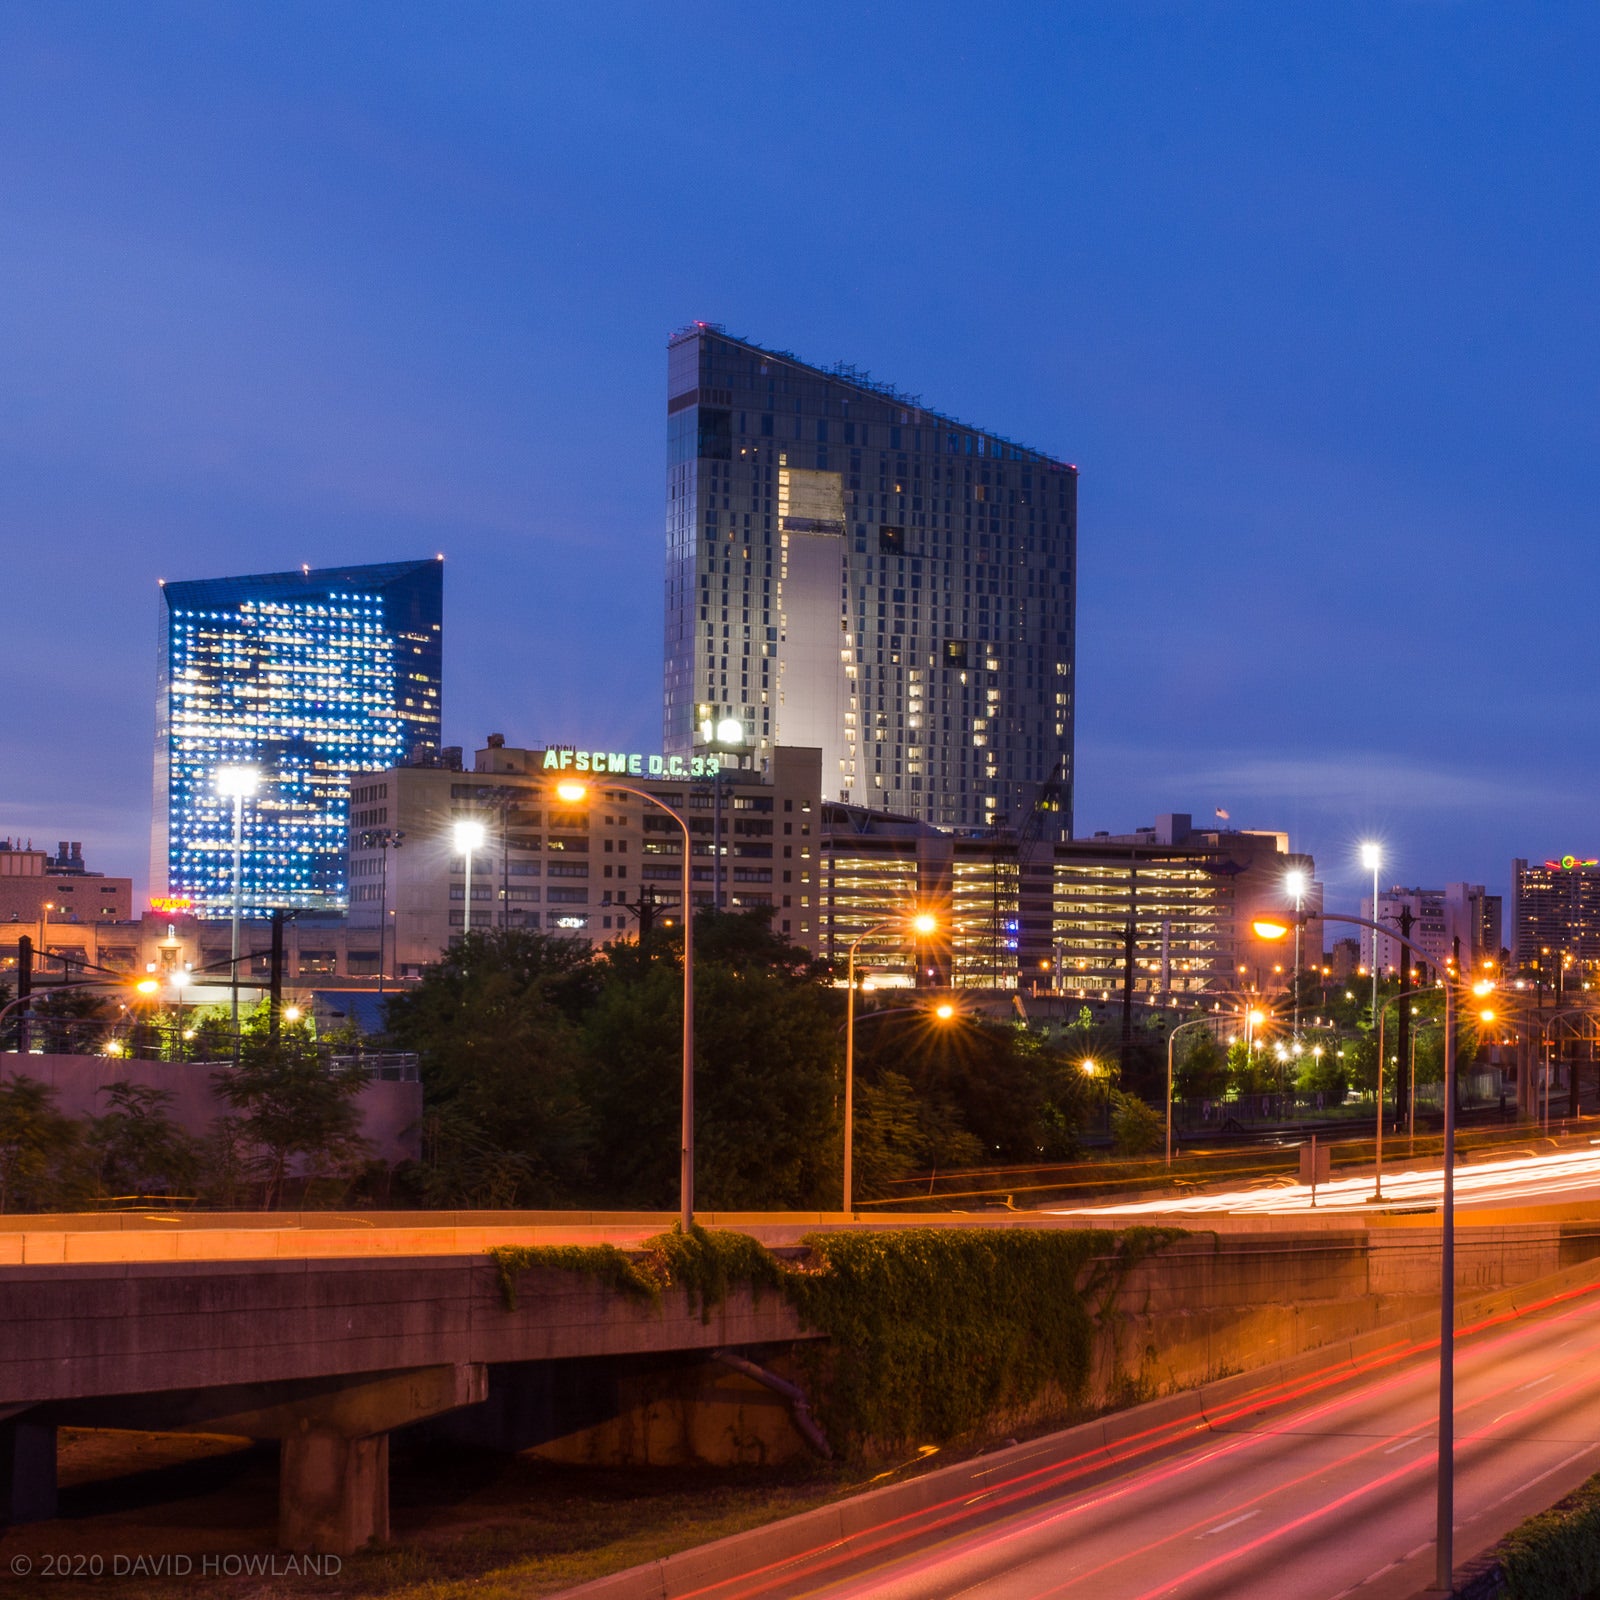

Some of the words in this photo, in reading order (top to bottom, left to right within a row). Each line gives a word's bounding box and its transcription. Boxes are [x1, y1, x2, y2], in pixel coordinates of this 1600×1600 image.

[543, 750, 642, 774] AFSCME
[648, 754, 688, 776] D.C.
[690, 757, 720, 777] 33
